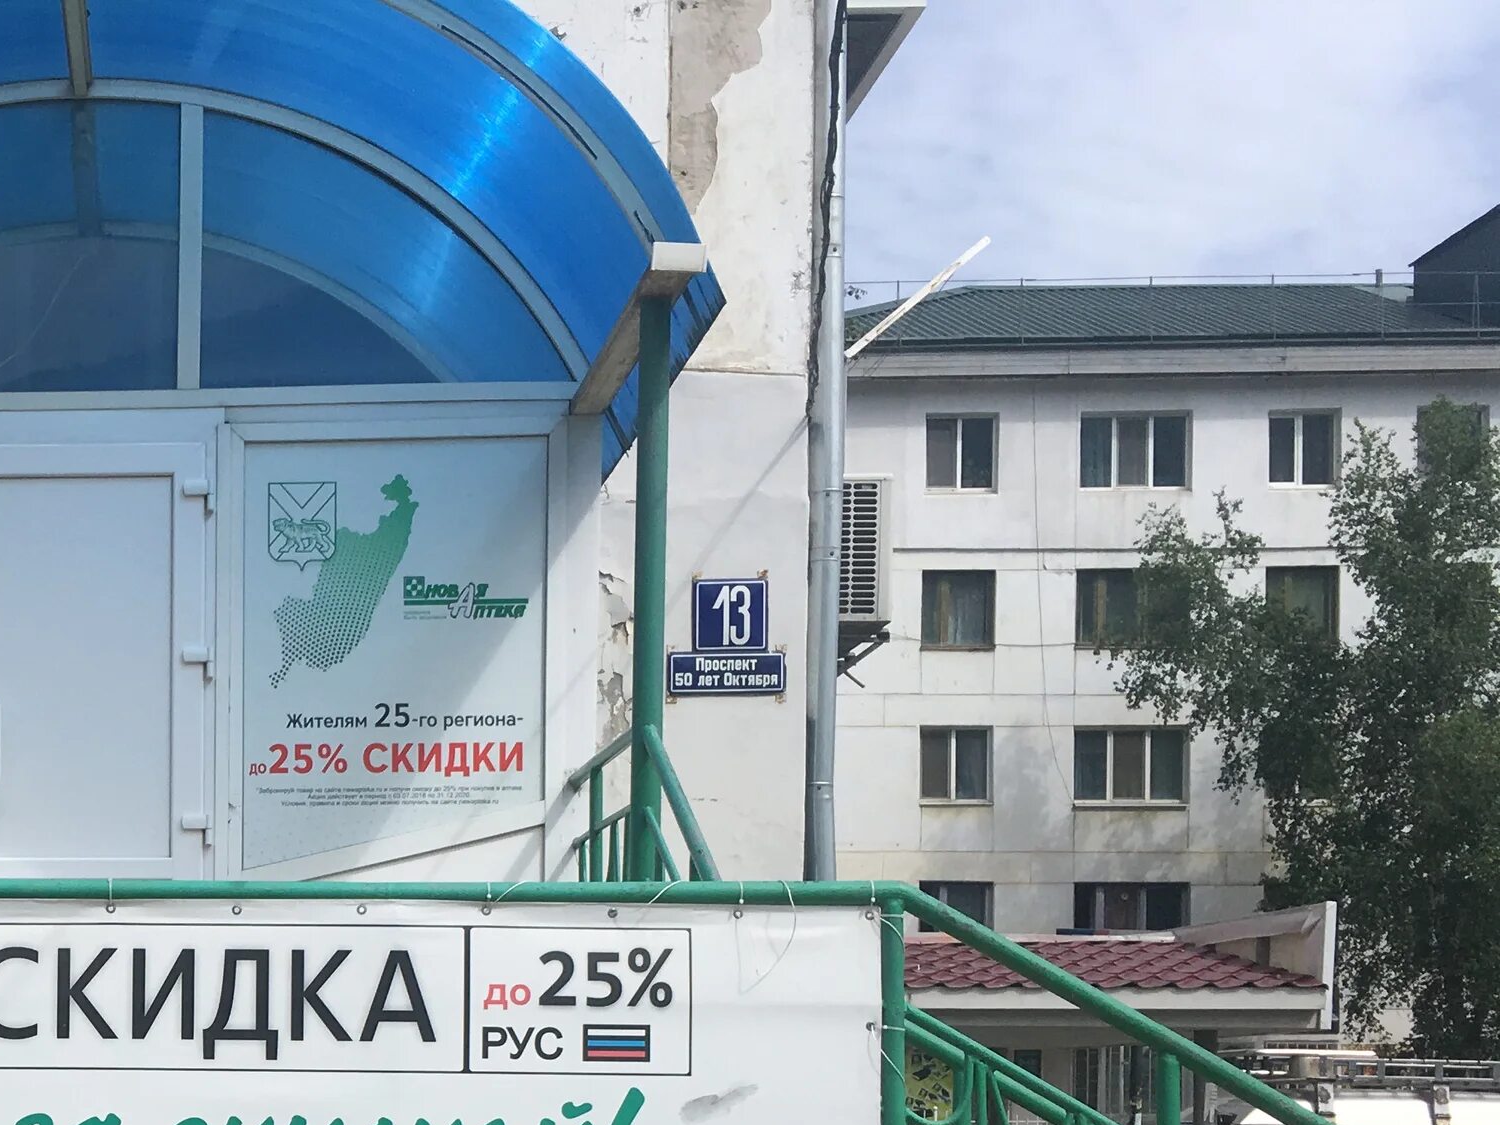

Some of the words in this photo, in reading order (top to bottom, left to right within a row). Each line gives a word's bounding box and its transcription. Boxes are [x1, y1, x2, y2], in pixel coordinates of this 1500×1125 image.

[712, 585, 751, 646] 13
[675, 672, 692, 686] 50
[698, 674, 720, 686] лет
[723, 672, 778, 687] Октября
[695, 658, 757, 673] Проспект
[286, 713, 367, 729] Жителям
[374, 703, 438, 728] 25-го
[268, 743, 348, 774] 25%
[362, 742, 524, 777] СКИДКИ
[483, 982, 531, 1010] до
[537, 947, 676, 1009] 25%
[482, 1026, 564, 1061] РУС
